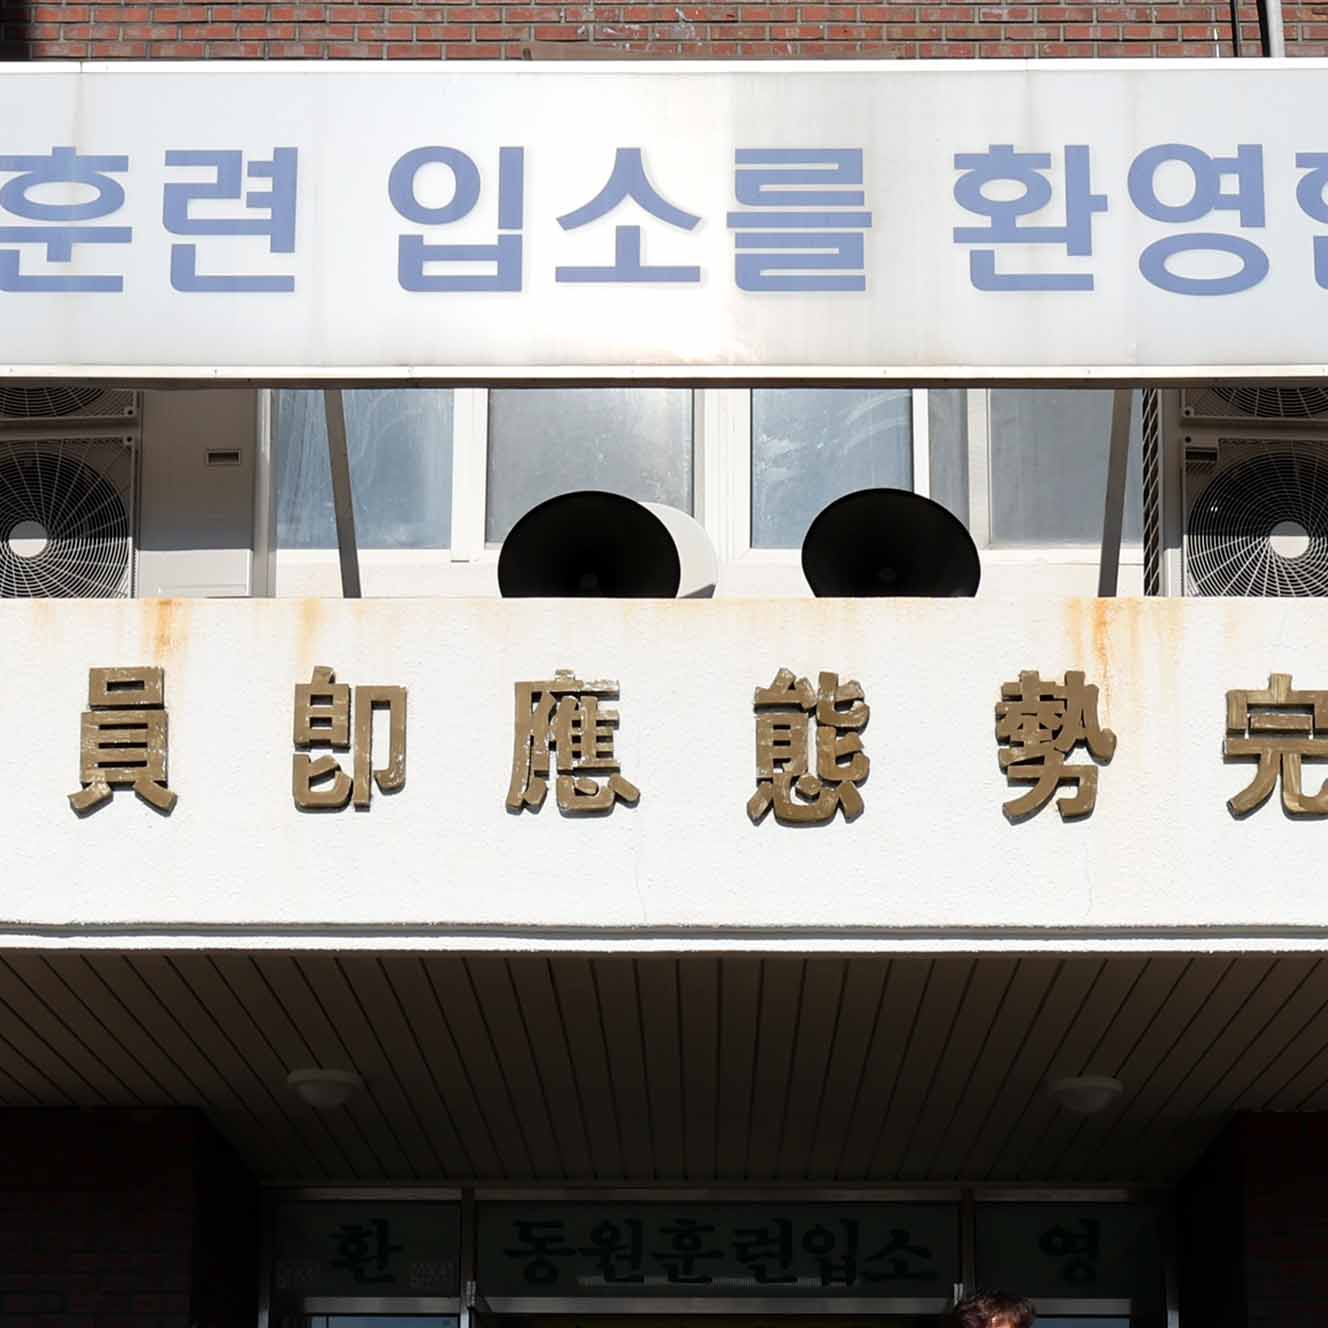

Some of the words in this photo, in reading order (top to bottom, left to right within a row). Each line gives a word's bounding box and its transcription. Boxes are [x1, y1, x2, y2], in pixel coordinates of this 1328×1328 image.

[388, 144, 872, 294] 입소를
[329, 1218, 403, 1284] 환
[503, 1217, 938, 1286] 동원훈련입소
[1037, 1217, 1102, 1283] 영
